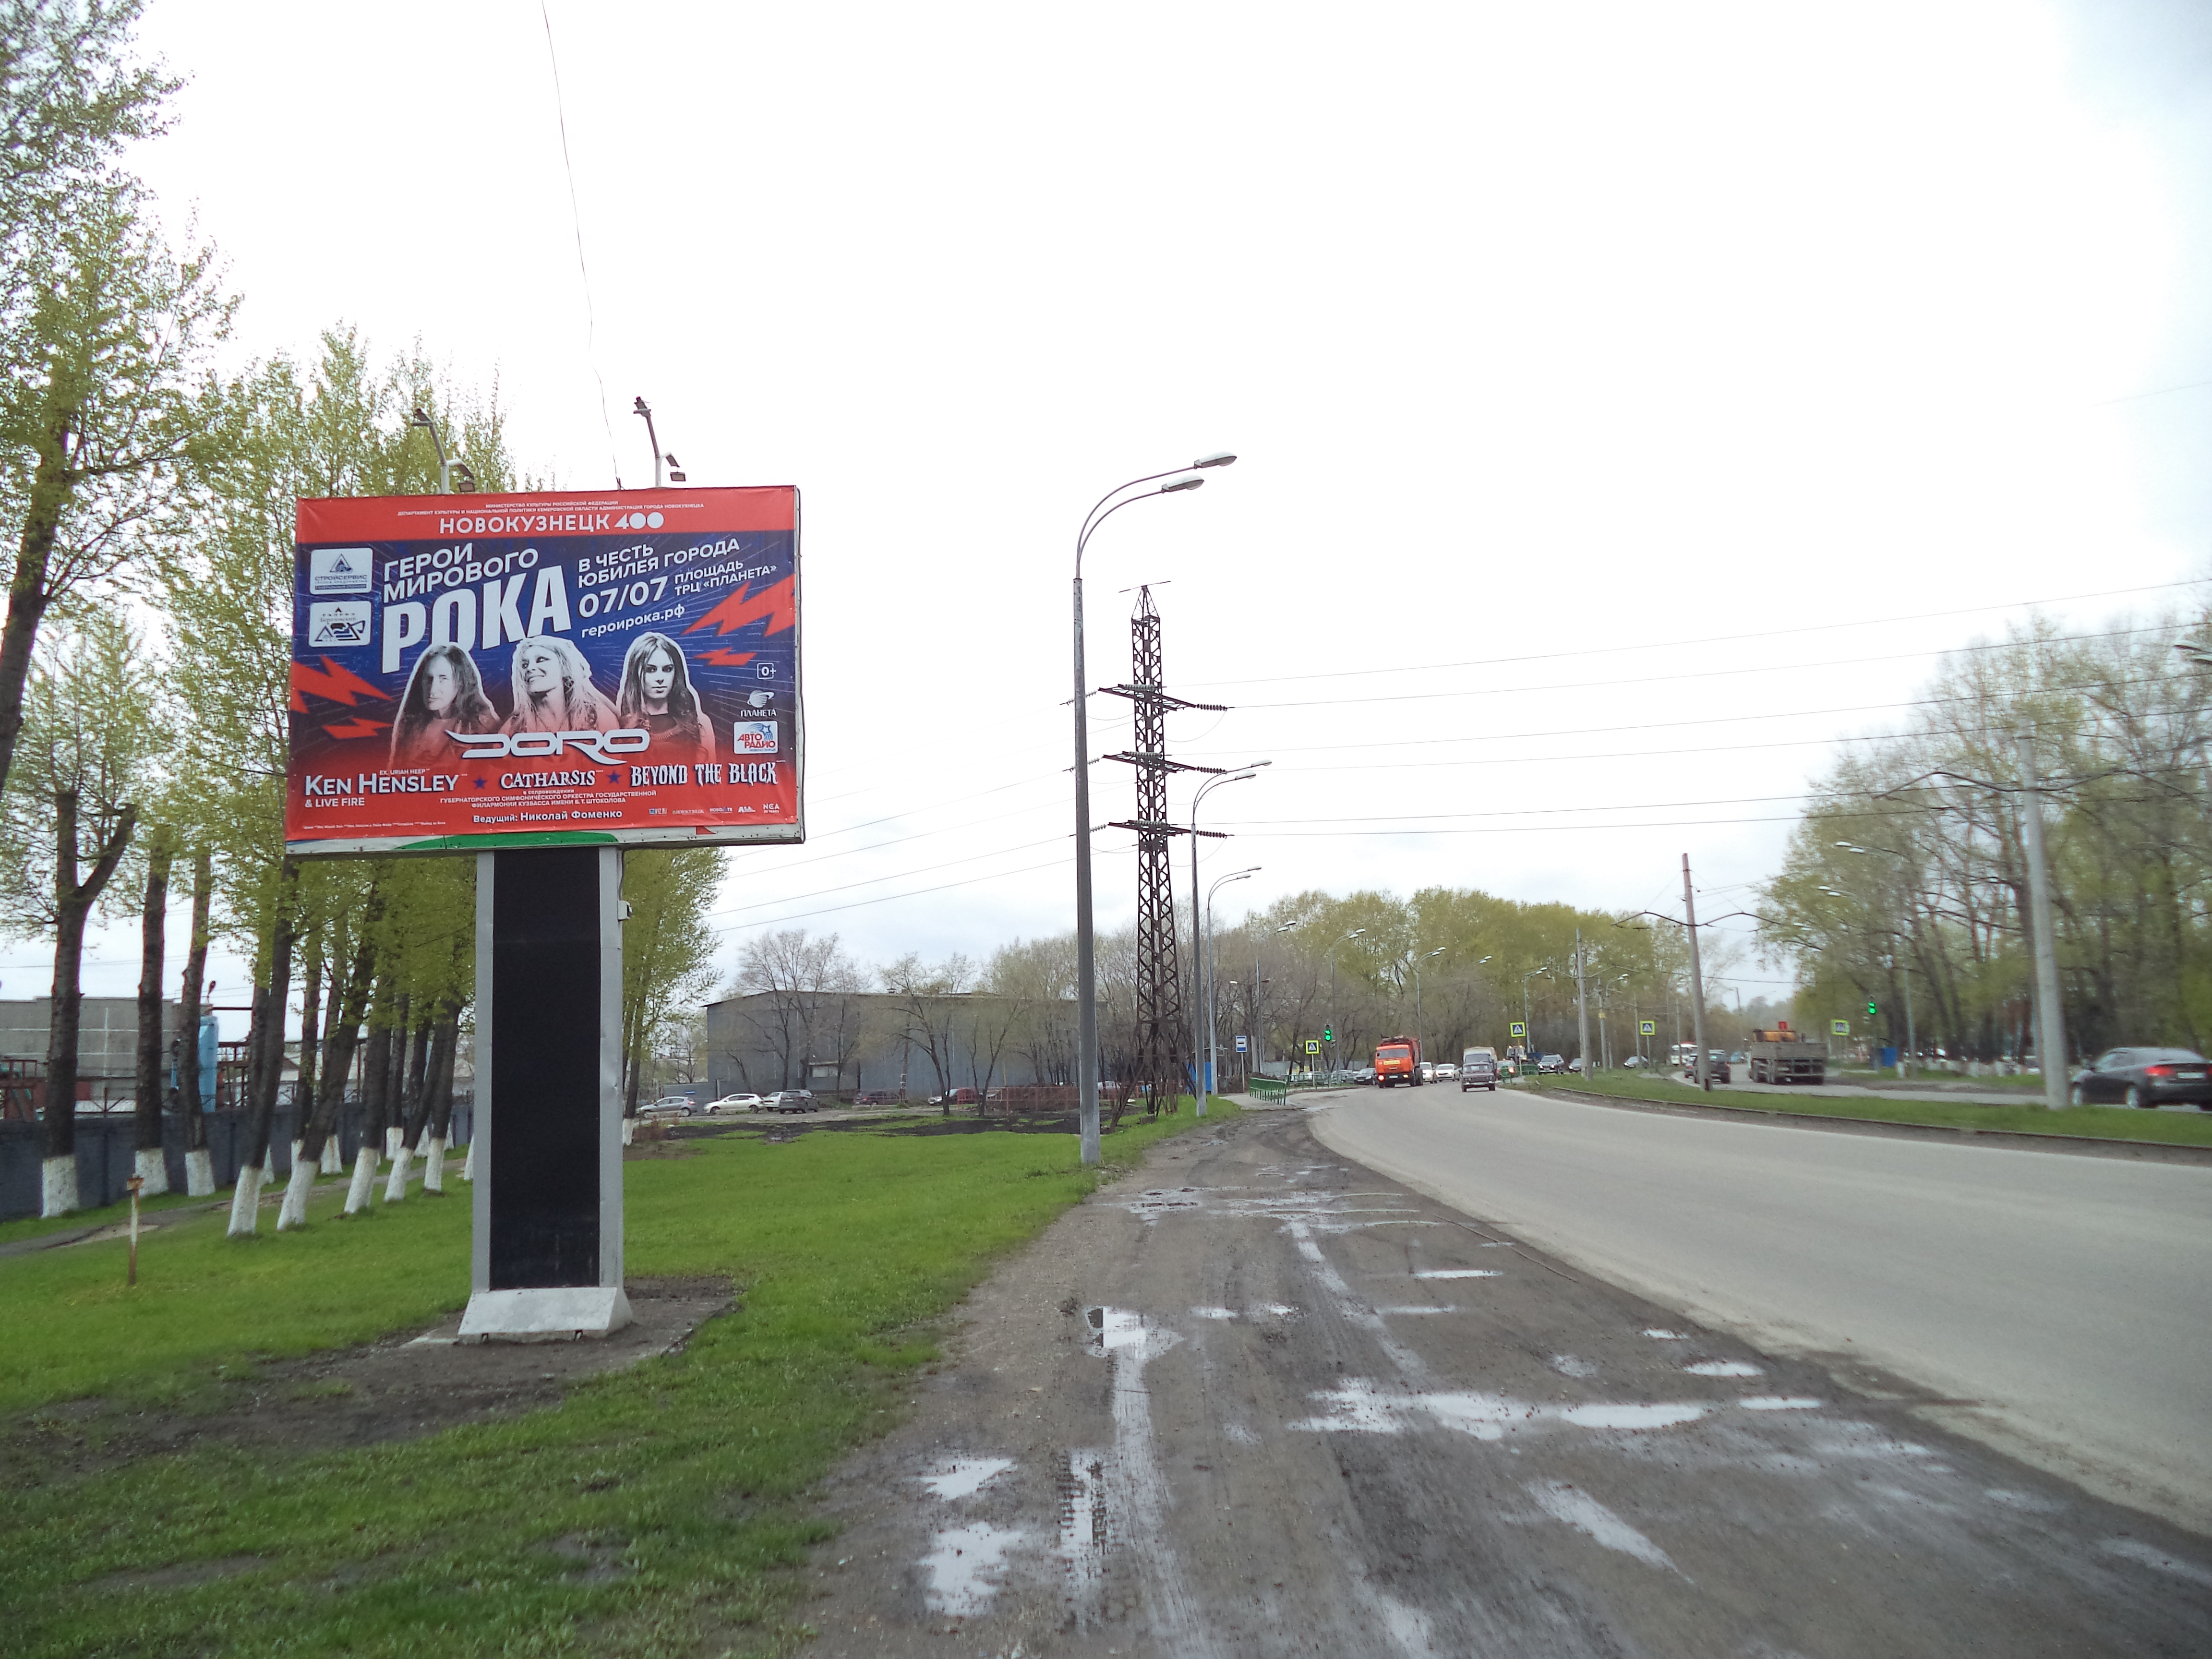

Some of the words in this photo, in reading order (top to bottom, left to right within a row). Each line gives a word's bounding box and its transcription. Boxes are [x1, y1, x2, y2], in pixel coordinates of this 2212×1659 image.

[440, 514, 610, 534] НОВОКУЗНЕЦК
[614, 512, 664, 529] 400
[384, 542, 472, 582] ГЕРОИ
[578, 558, 590, 572] В
[596, 544, 653, 567] ЧЕСТЬ
[578, 556, 659, 589] ЮБИЛЕЯ
[664, 537, 740, 567] ГОРОДА
[384, 548, 539, 603] МИРОВОГО
[674, 560, 744, 584] ПЛОЩАДЬ
[674, 581, 700, 596] ТРЦ
[703, 565, 777, 588] «ПЛАНЕТА»
[578, 576, 668, 618] 07/07
[382, 565, 572, 674] РОКА
[581, 603, 685, 638] героирока.рф
[761, 666, 777, 676] 0+
[740, 709, 777, 717] ПЛАНЕТА
[445, 728, 650, 765] DORO
[737, 733, 763, 742] АВТО
[744, 740, 776, 749] РАДИО
[305, 774, 351, 796] KEN
[630, 763, 688, 787] BEYOND
[694, 762, 722, 787] THE
[728, 761, 779, 786] BLACK
[304, 798, 313, 808] &
[315, 798, 338, 808] LIVE
[341, 797, 365, 807] FIRE
[502, 793, 561, 802] СИМФОНИЧЕСКОГО
[595, 790, 657, 798] ГОСУДАРСТВЕННОЙ
[473, 814, 518, 824] Ведущий:
[520, 810, 568, 821] Николай
[571, 809, 623, 819] Фоменко
